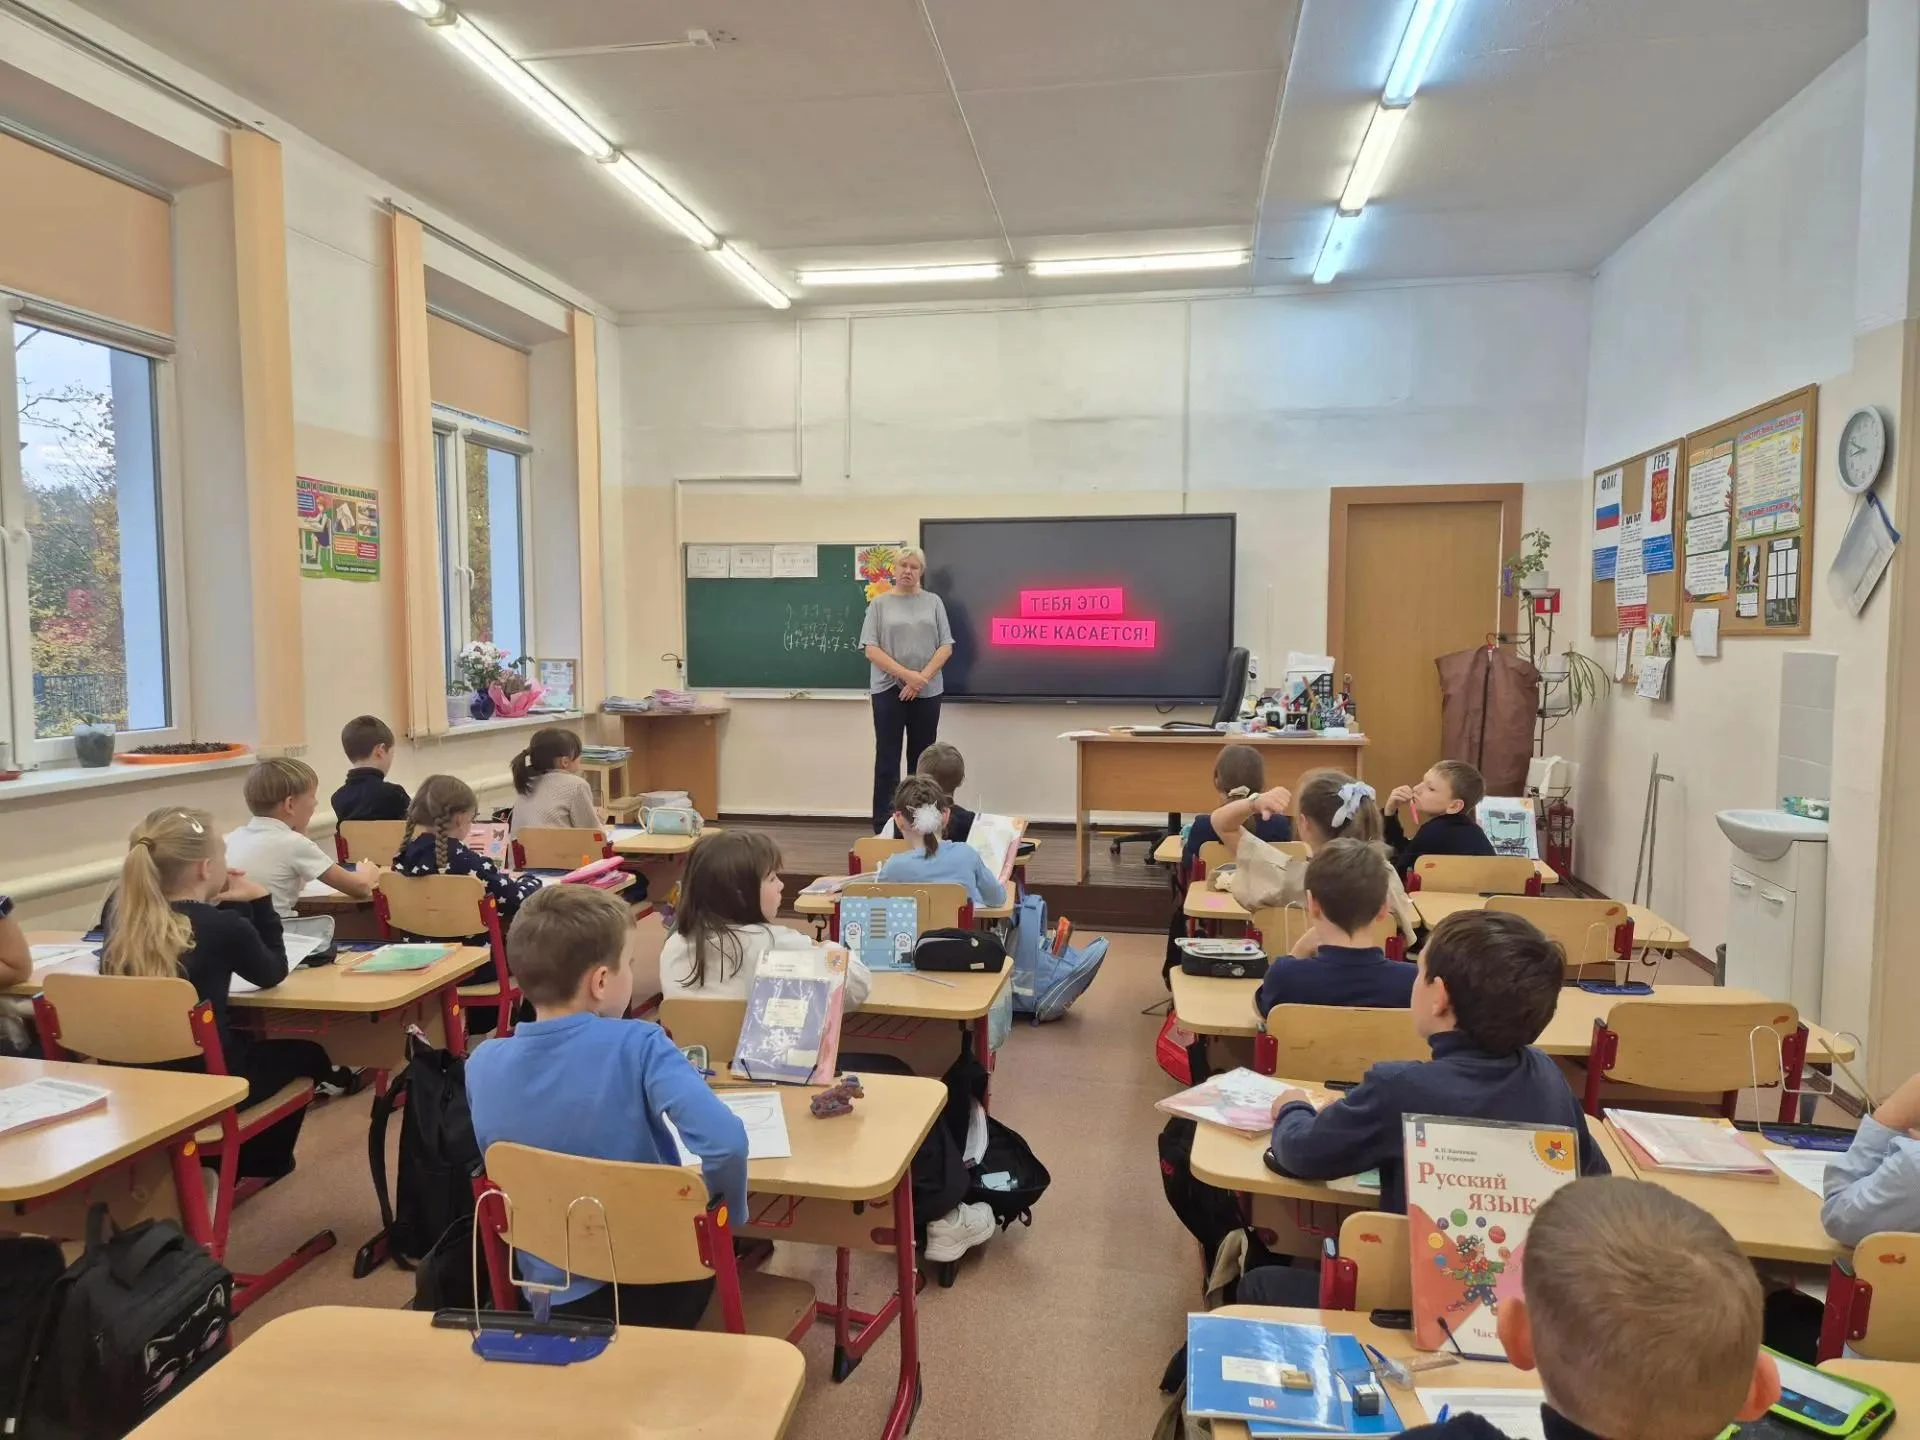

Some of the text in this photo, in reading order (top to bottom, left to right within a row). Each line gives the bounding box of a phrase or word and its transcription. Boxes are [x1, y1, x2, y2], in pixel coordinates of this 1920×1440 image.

[1653, 452, 1670, 470] ГЕРБ
[1601, 473, 1618, 490] ФЛАГ
[1030, 594, 1111, 612] ТЕБЯ ЭТО
[999, 624, 1149, 641] ТОЖЕ КАСАЕТСЯ!
[1417, 1161, 1507, 1190] Русский
